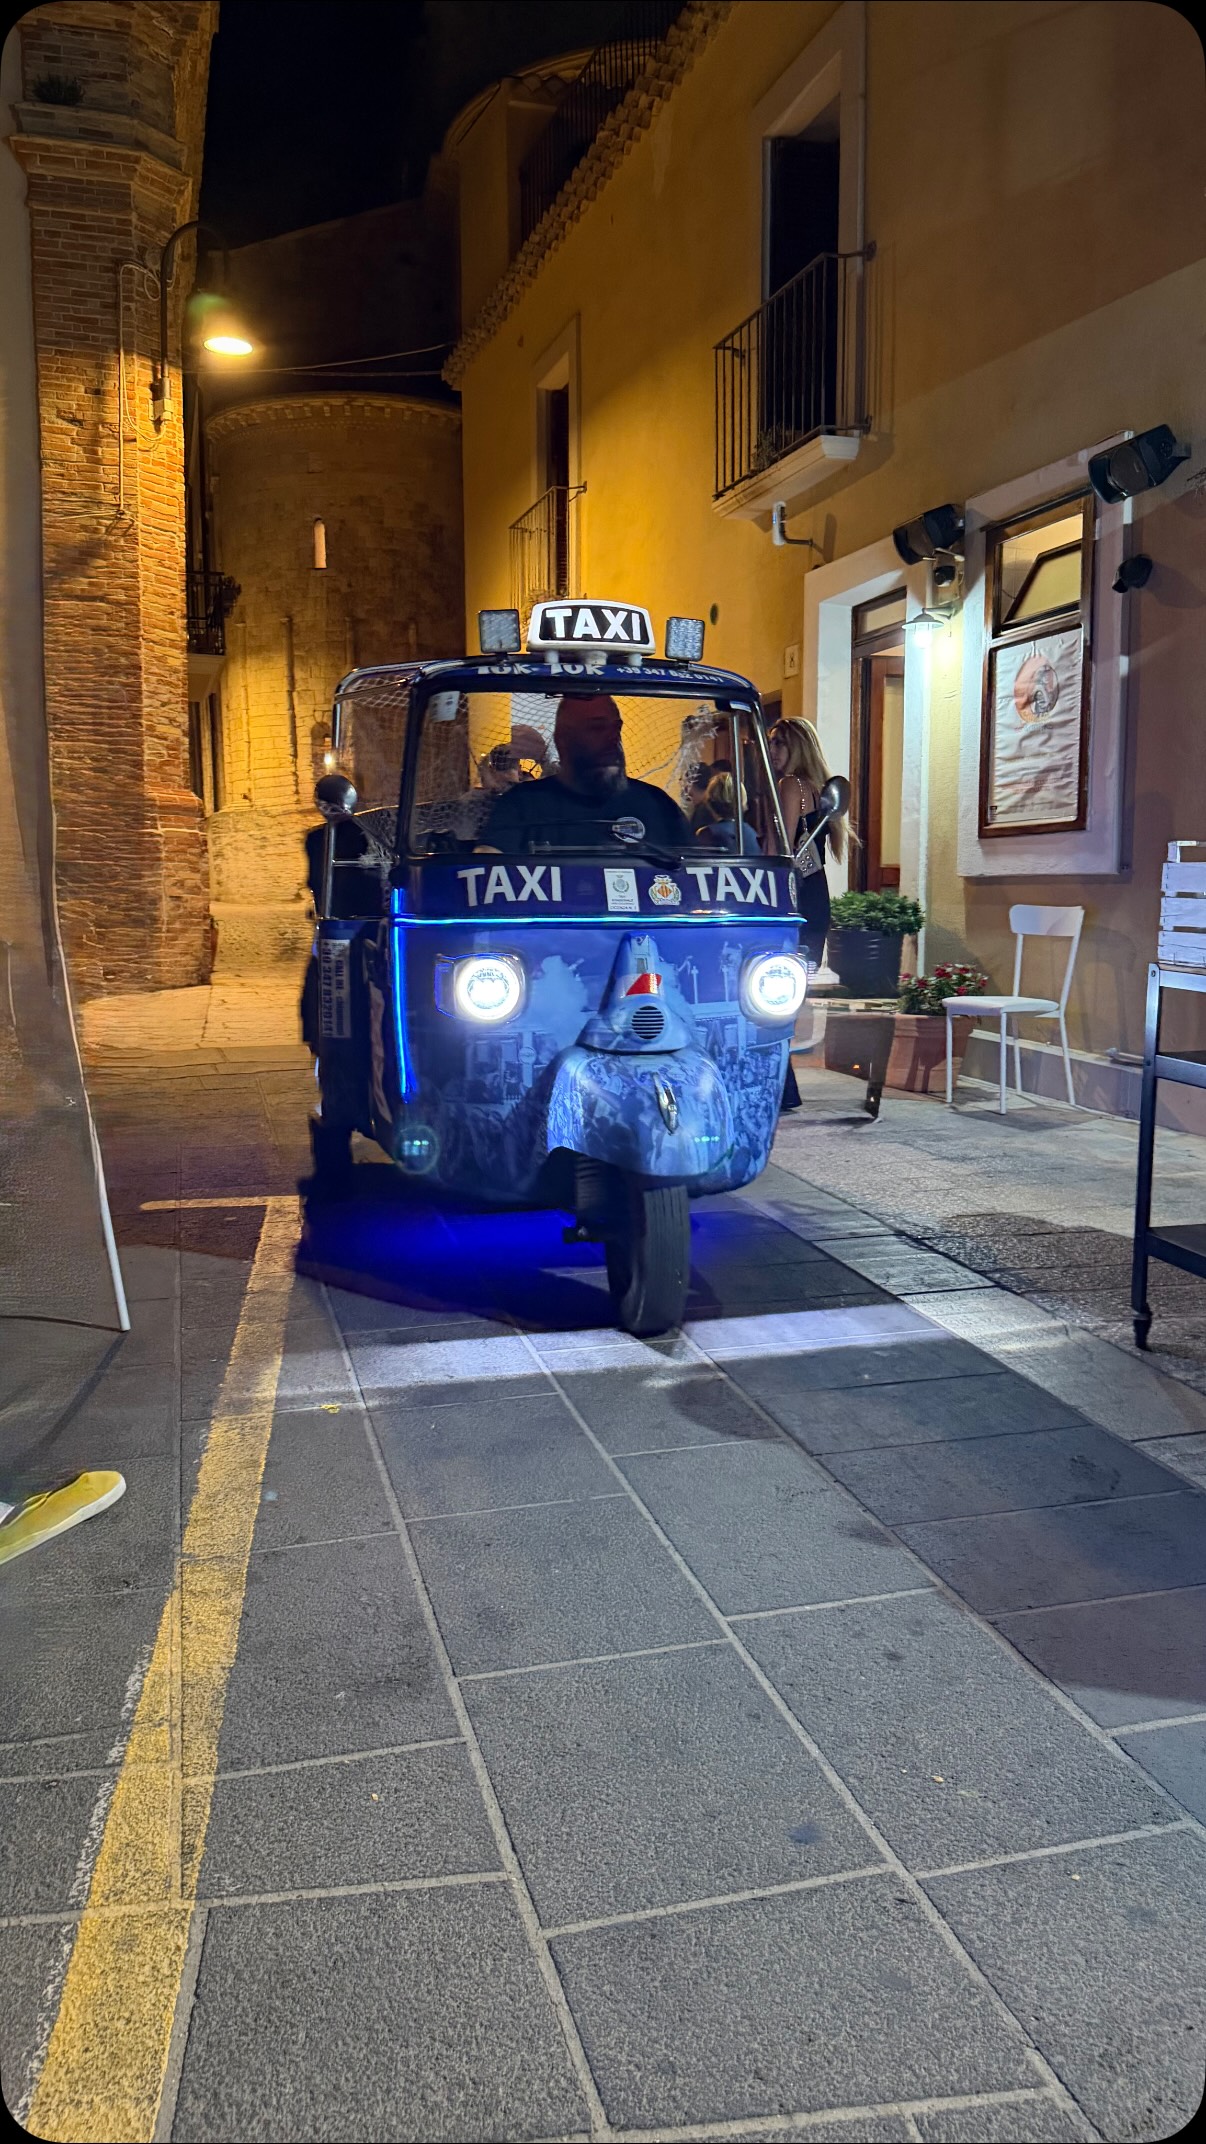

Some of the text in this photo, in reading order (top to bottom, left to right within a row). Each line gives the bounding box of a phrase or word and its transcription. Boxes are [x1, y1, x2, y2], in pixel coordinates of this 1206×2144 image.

[546, 608, 641, 641] TAXI
[616, 666, 641, 674] +39
[643, 667, 666, 676] 347
[457, 865, 562, 907] TAXI
[686, 867, 778, 908] TAXI
